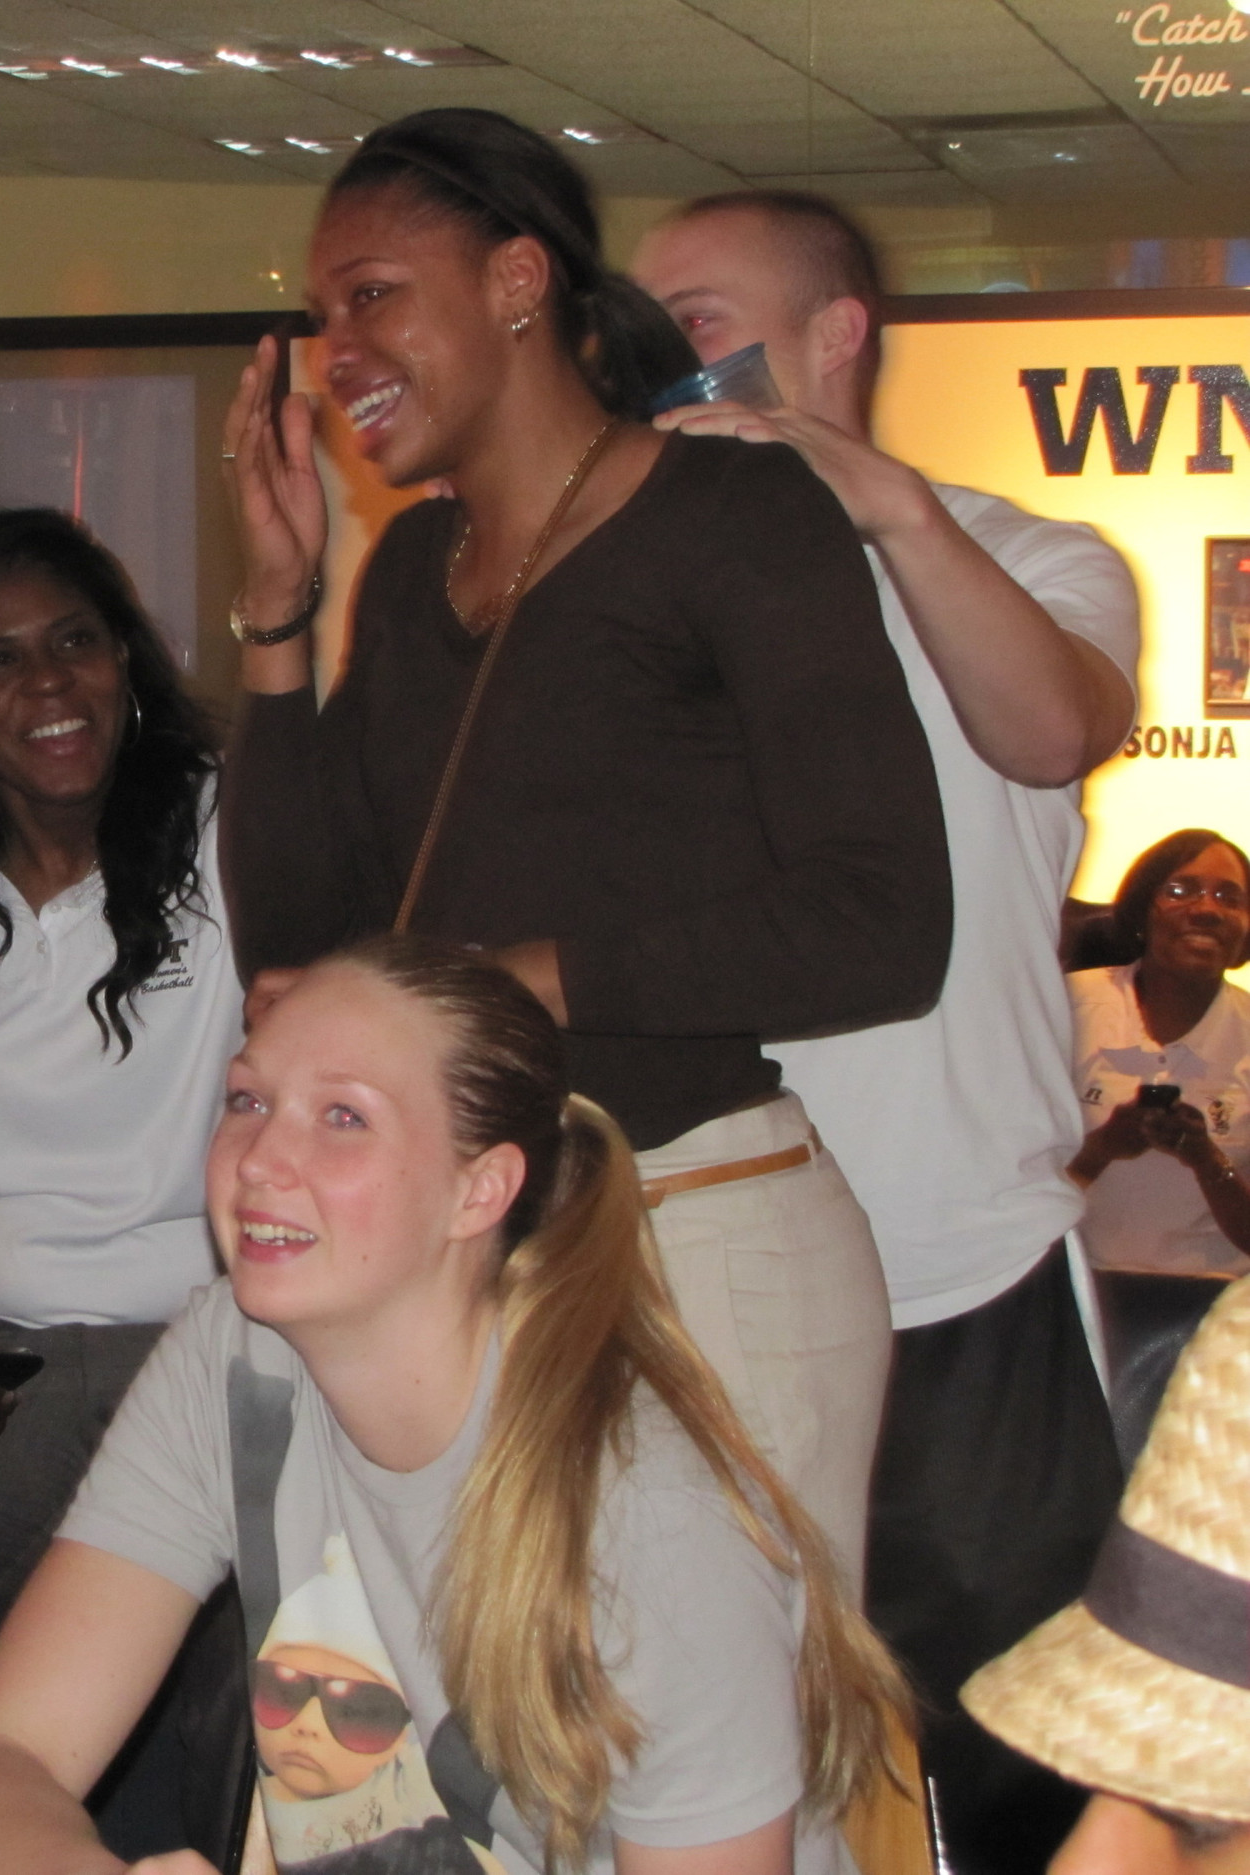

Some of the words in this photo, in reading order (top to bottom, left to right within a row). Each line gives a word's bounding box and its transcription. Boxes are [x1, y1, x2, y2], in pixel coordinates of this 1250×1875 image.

[1134, 55, 1231, 107] How
[1123, 725, 1237, 760] SONJA
[140, 976, 194, 995] Basketball
